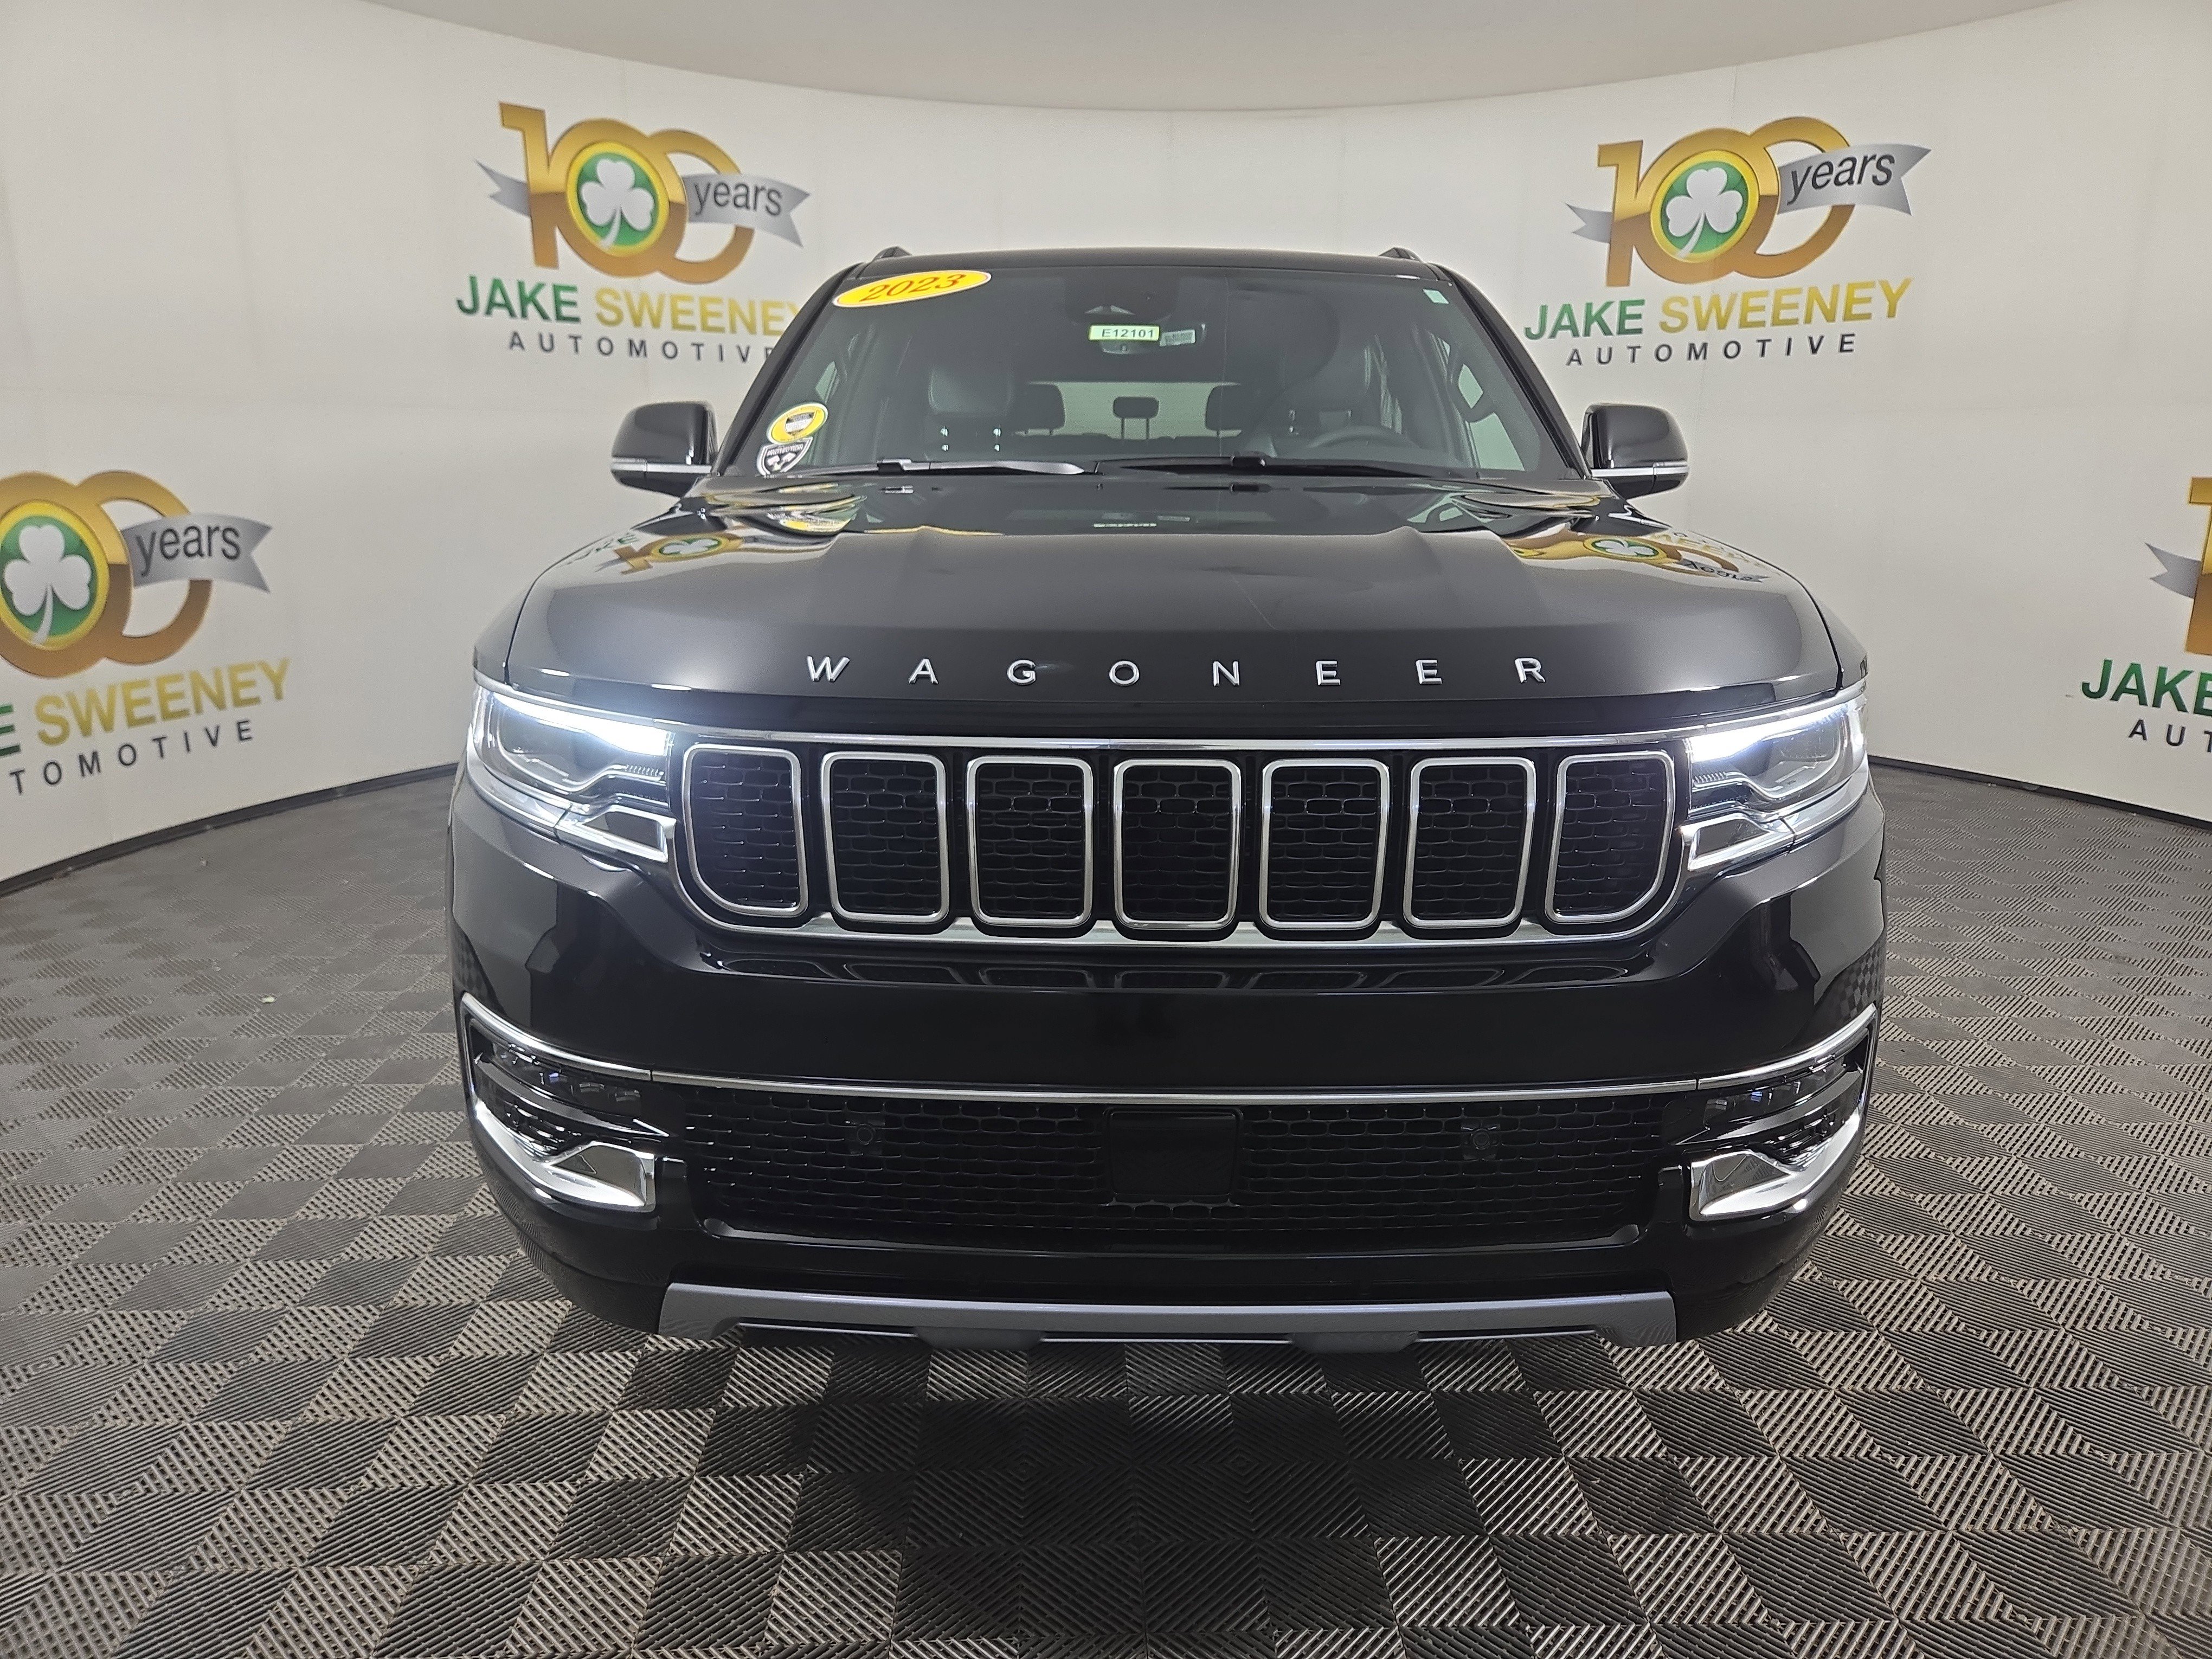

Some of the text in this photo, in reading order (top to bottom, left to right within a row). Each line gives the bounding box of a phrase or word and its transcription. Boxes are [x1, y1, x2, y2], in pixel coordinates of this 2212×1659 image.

[498, 101, 754, 285] 100
[695, 180, 783, 216] years
[1597, 116, 1856, 287] 100
[1787, 153, 1895, 206] years
[456, 275, 800, 337] JAKE SWEENE
[859, 273, 967, 303] 2023
[1524, 277, 1913, 341] JAKE SWEENEY
[1102, 328, 1154, 338] E12101
[1566, 333, 1856, 366] AUTOMOTIVE
[136, 524, 242, 576] years
[806, 656, 1546, 686] WAGONEER
[34, 658, 290, 747] SWEENEY
[9, 719, 253, 795] TOMOTIVE
